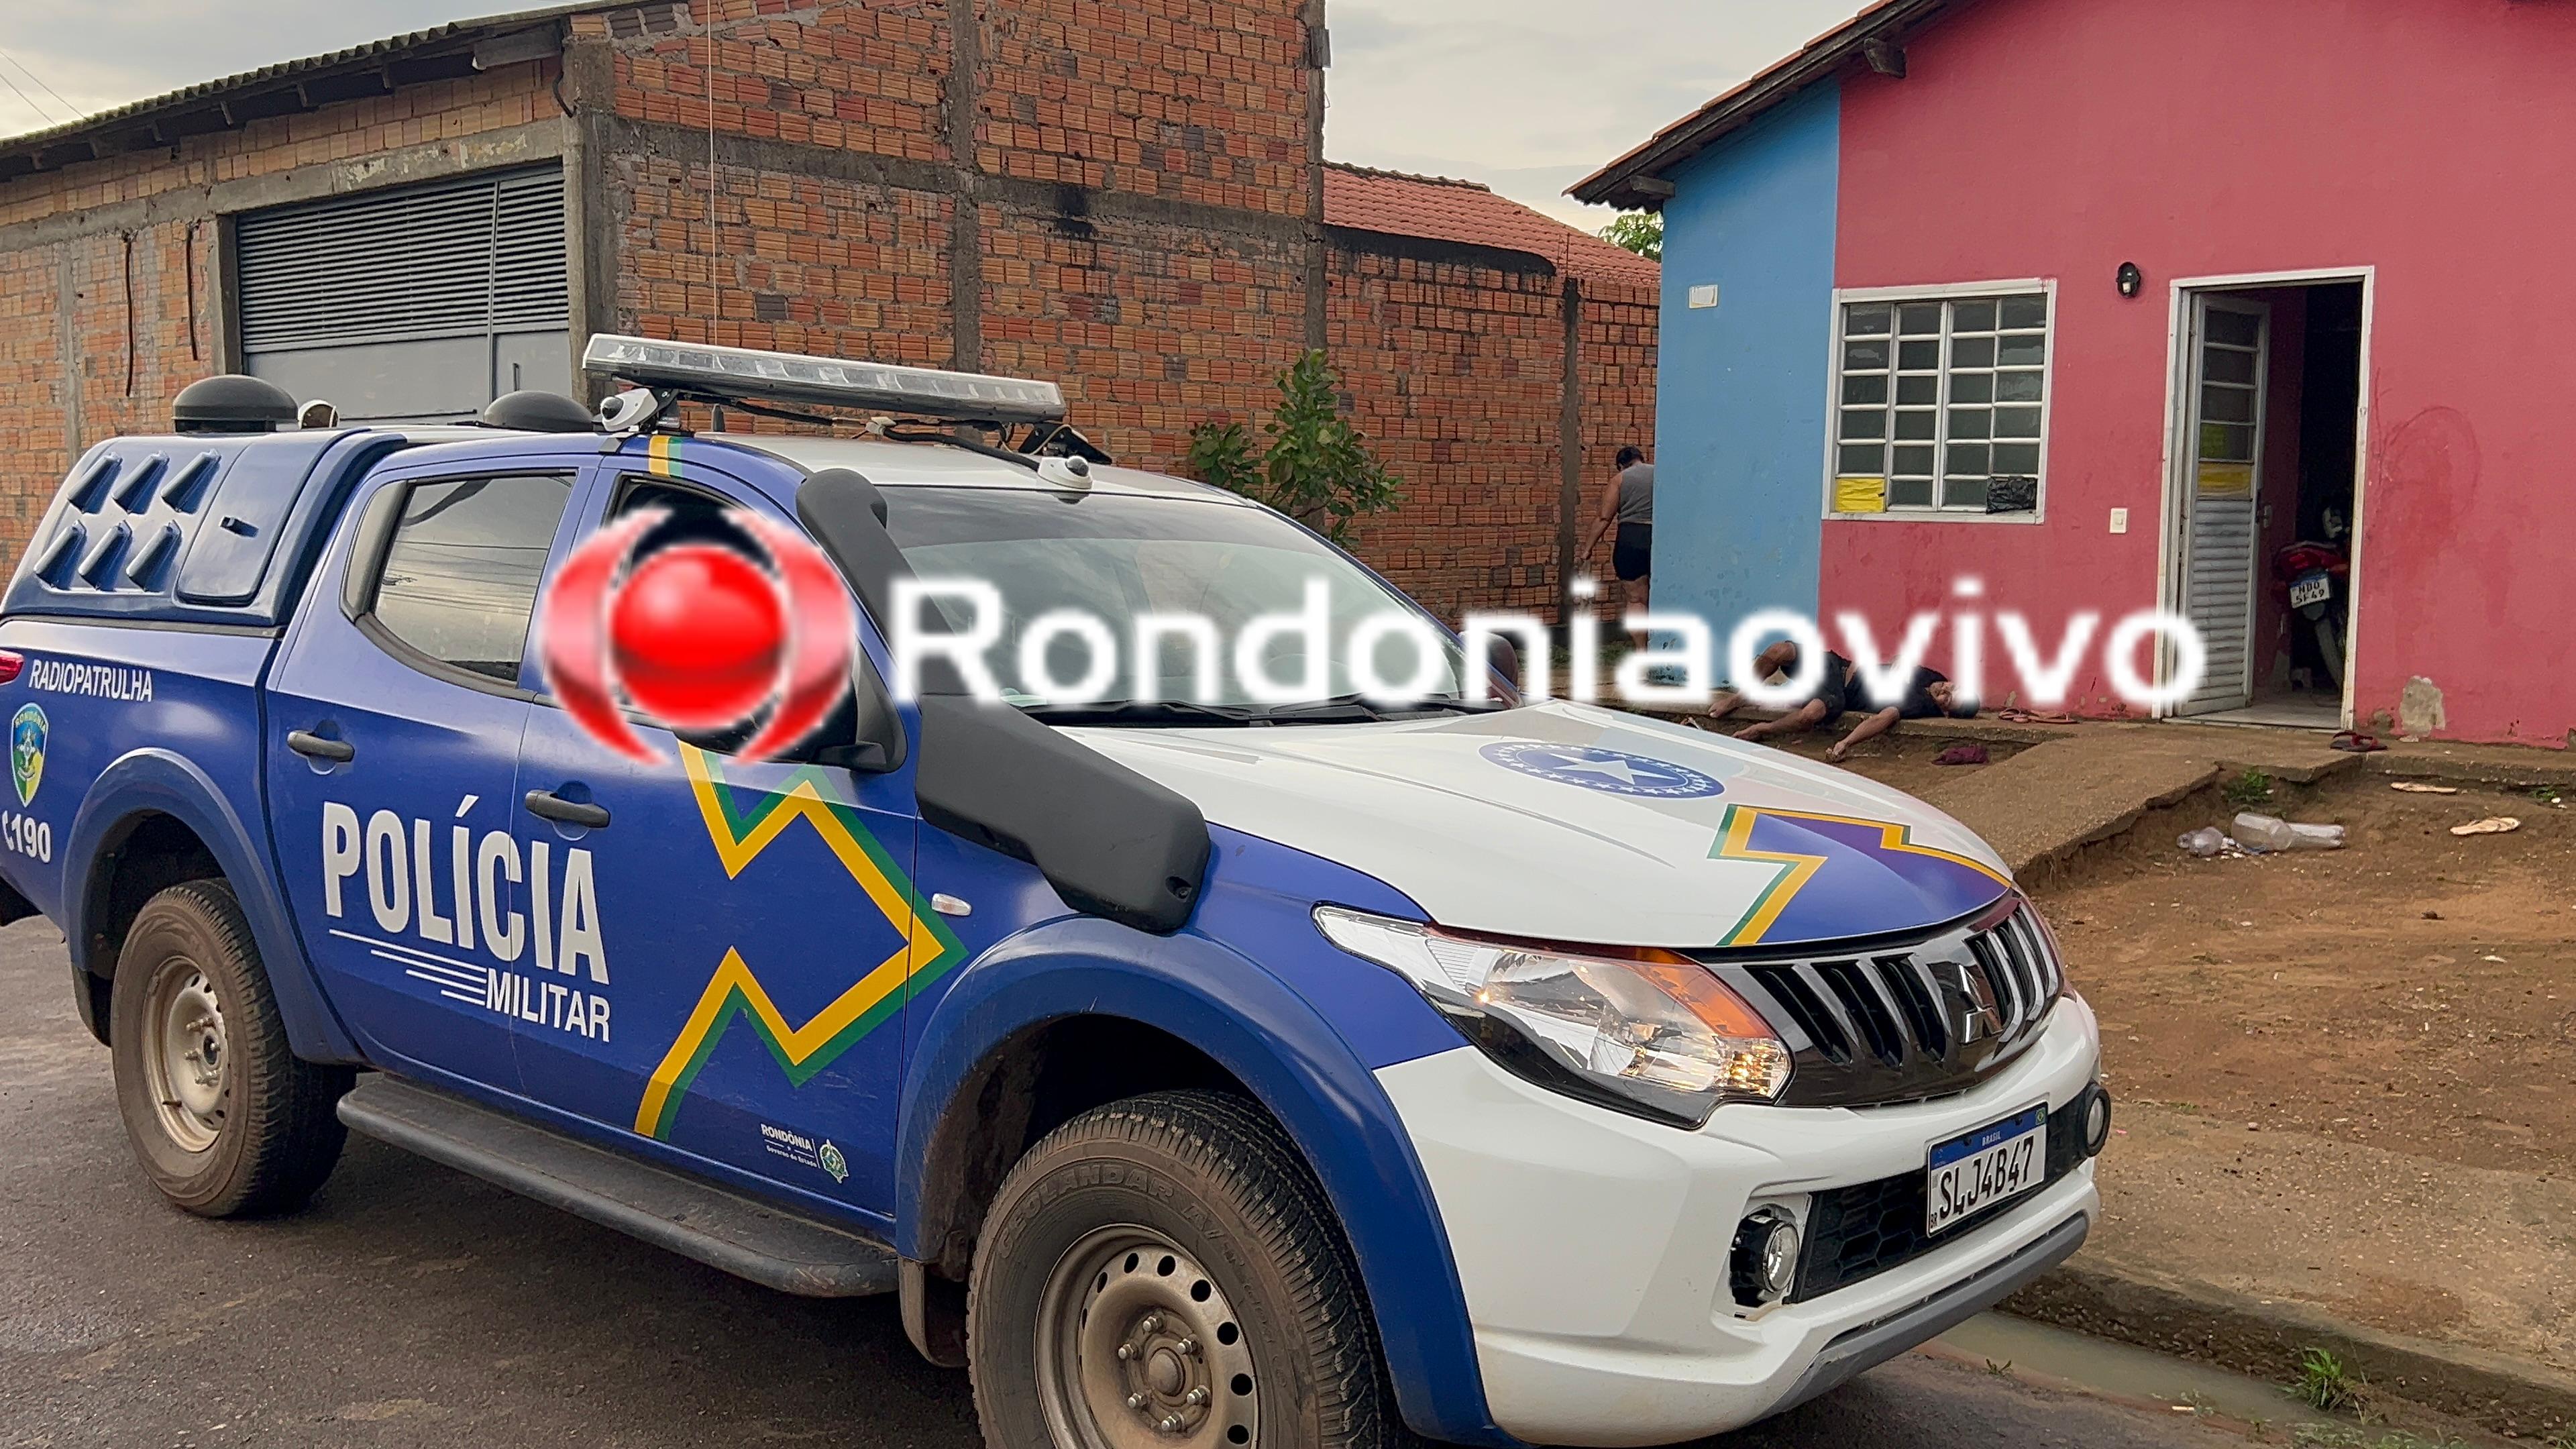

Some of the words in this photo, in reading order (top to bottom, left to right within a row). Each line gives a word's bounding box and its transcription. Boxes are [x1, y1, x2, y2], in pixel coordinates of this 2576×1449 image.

[29, 659, 153, 702] RADIOPATRULHA
[323, 794, 610, 985] POLÍCIA
[486, 968, 610, 1042] MILITAR
[761, 1124, 813, 1151] RONDÔNIA
[1982, 1131, 2001, 1146] BRASIL
[1939, 1135, 2035, 1219] SLJ4B47
